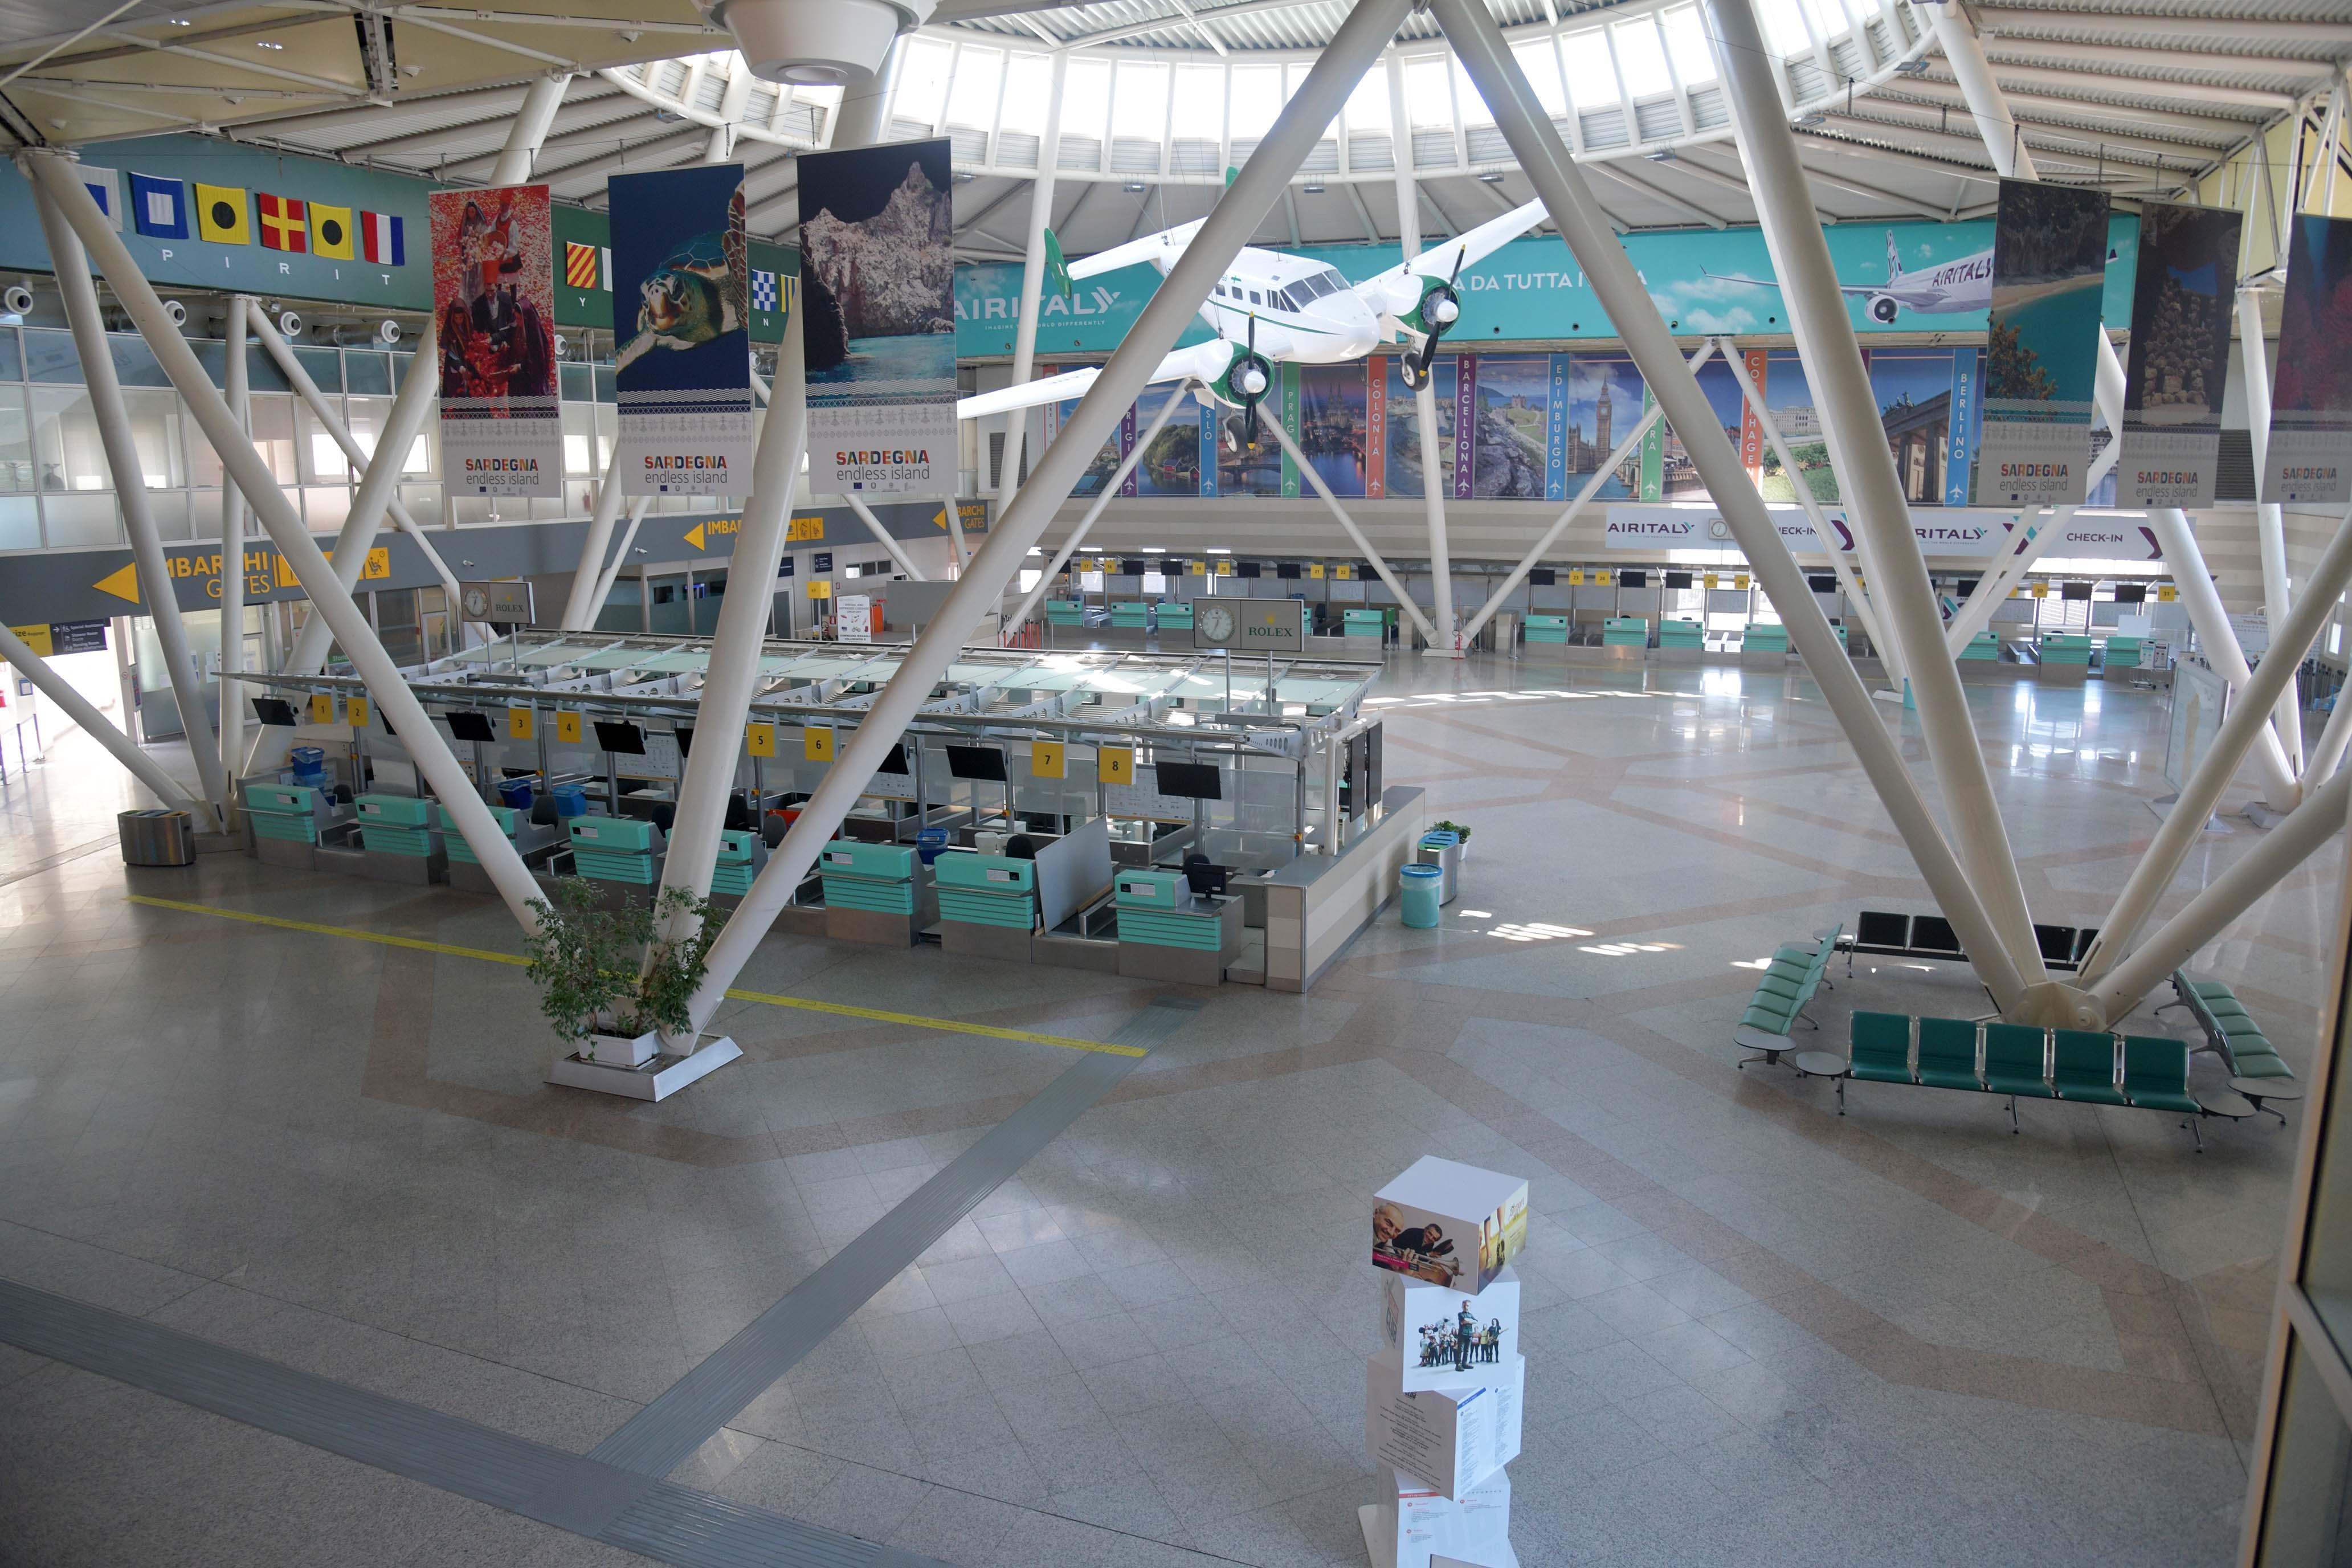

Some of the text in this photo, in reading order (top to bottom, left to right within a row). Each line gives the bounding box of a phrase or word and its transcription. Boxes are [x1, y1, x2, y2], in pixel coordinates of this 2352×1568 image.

[1471, 275, 1500, 291] DA
[1504, 272, 1573, 289] TUTTA
[1372, 379, 1381, 456] COLONIA
[1460, 360, 1470, 473] BARCELLONA
[1551, 365, 1563, 468] EDIMBURGO
[1746, 357, 1759, 476] CONHAGEN
[1954, 373, 1967, 459] BERLINO
[644, 456, 727, 469] SARDEGNA
[836, 450, 929, 465] SARDEGNA
[466, 459, 538, 471] SARDEGNA
[2001, 464, 2068, 477] SARDEGNA
[466, 473, 538, 484] endless island
[645, 471, 727, 483] endless island
[837, 466, 929, 480] endless island
[2138, 472, 2198, 484] SARDEGNA
[2282, 467, 2336, 479] SARDEGNA
[2000, 477, 2068, 491] endless island
[2281, 480, 2336, 492] endless island
[2137, 485, 2198, 497] endless island
[957, 505, 985, 517] BARCHI
[965, 517, 985, 529] GATES
[1608, 521, 1695, 534] AIRITALY
[1779, 526, 1816, 535] ECK-IN
[1915, 526, 1988, 540] RITALY
[2067, 533, 2123, 542] CHECK-IN
[1248, 627, 1293, 637] ROLEX
[518, 719, 523, 728] 3
[567, 723, 571, 732] 4
[758, 736, 763, 745] 5
[816, 740, 821, 749] 6
[1044, 755, 1050, 765] 7
[1112, 761, 1118, 771] 8
